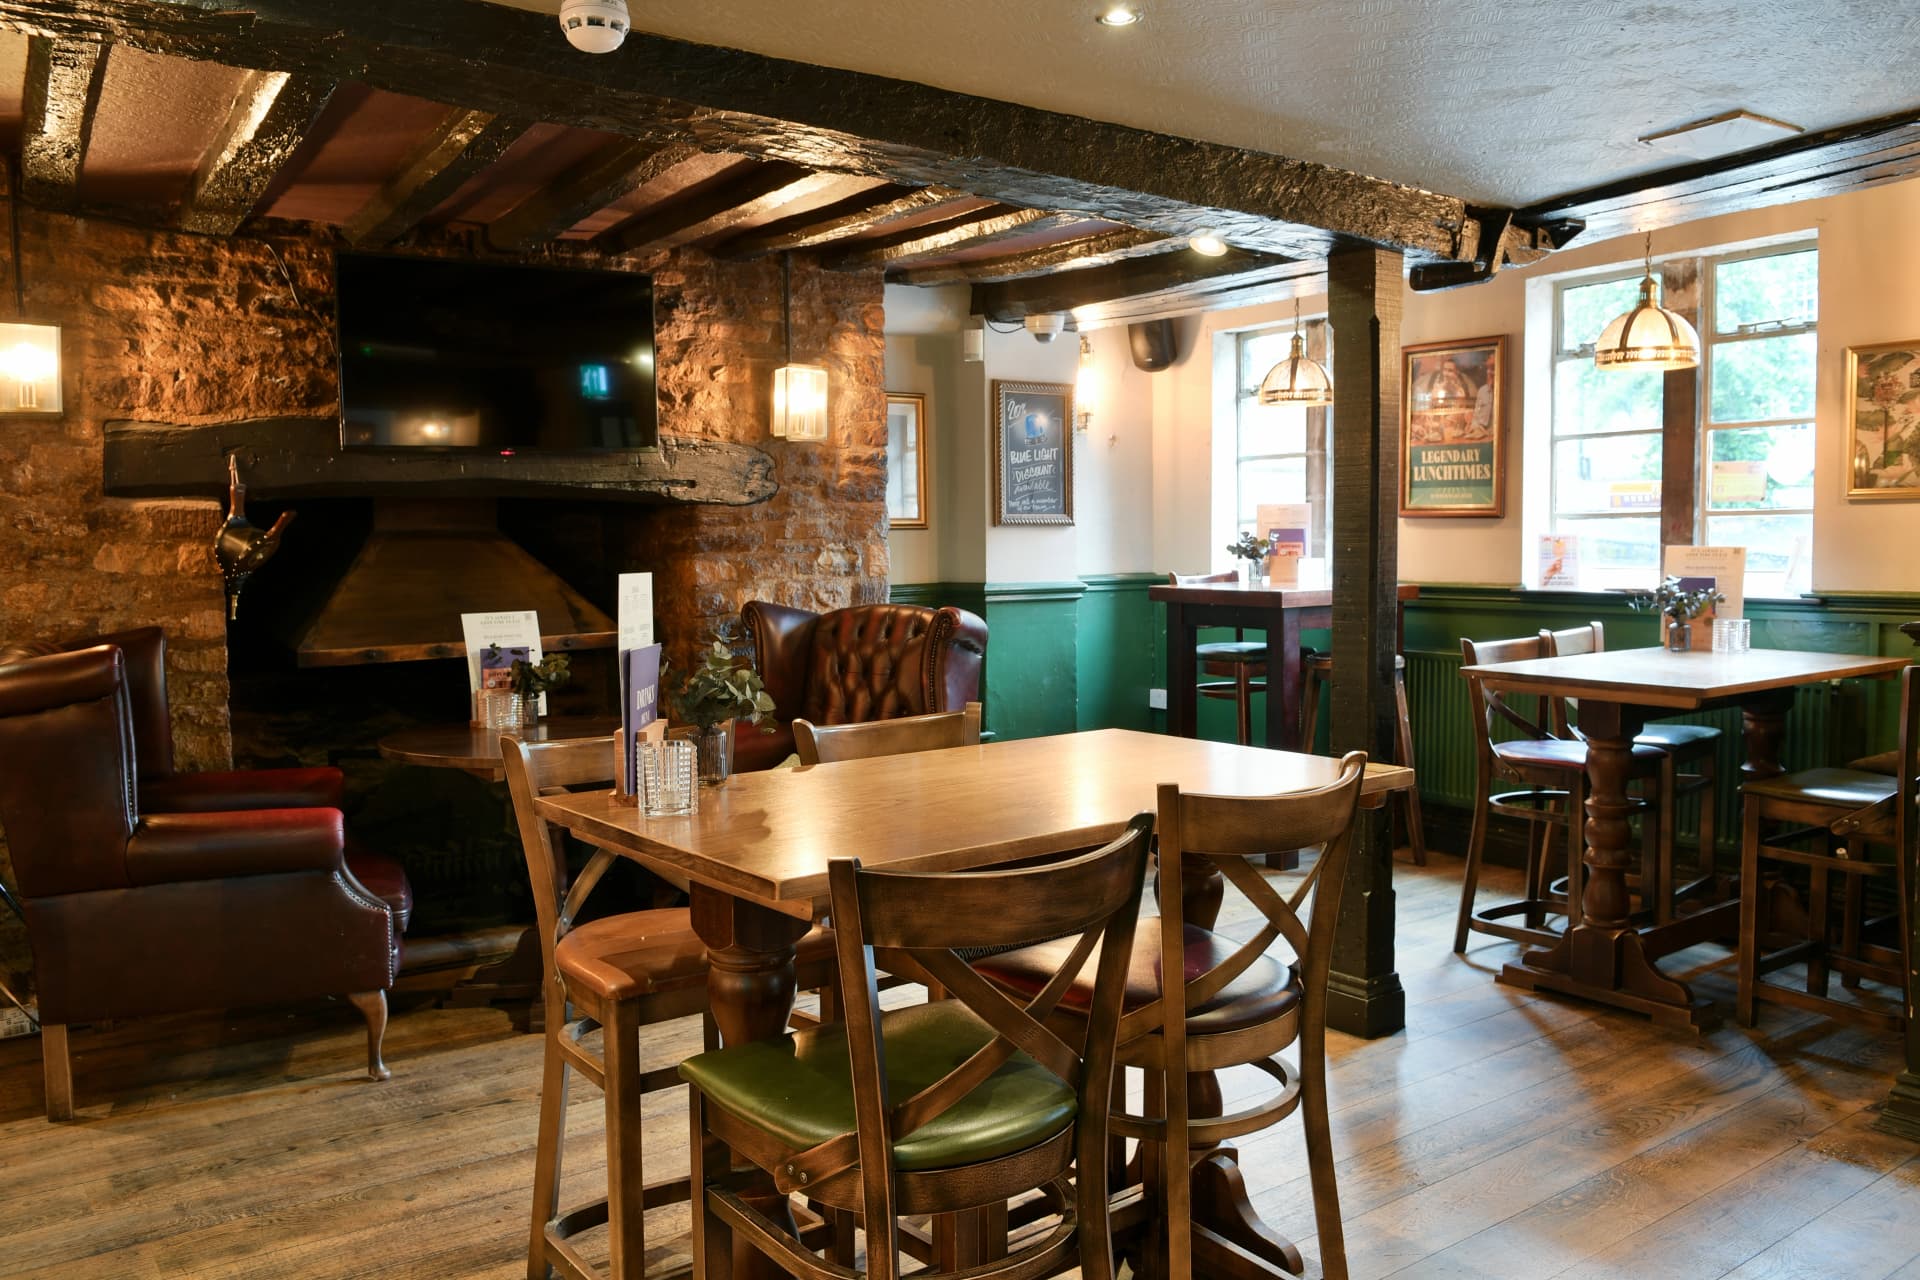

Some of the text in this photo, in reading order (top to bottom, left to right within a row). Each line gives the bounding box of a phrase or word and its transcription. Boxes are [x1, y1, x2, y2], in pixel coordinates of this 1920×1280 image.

[1010, 447, 1058, 464] BLUE LIGHT
[1421, 448, 1480, 464] LEGENDARY
[1015, 463, 1053, 483] DISCOUNT
[1413, 463, 1491, 481] LUNCHTIMES
[636, 684, 655, 710] DRINKS
